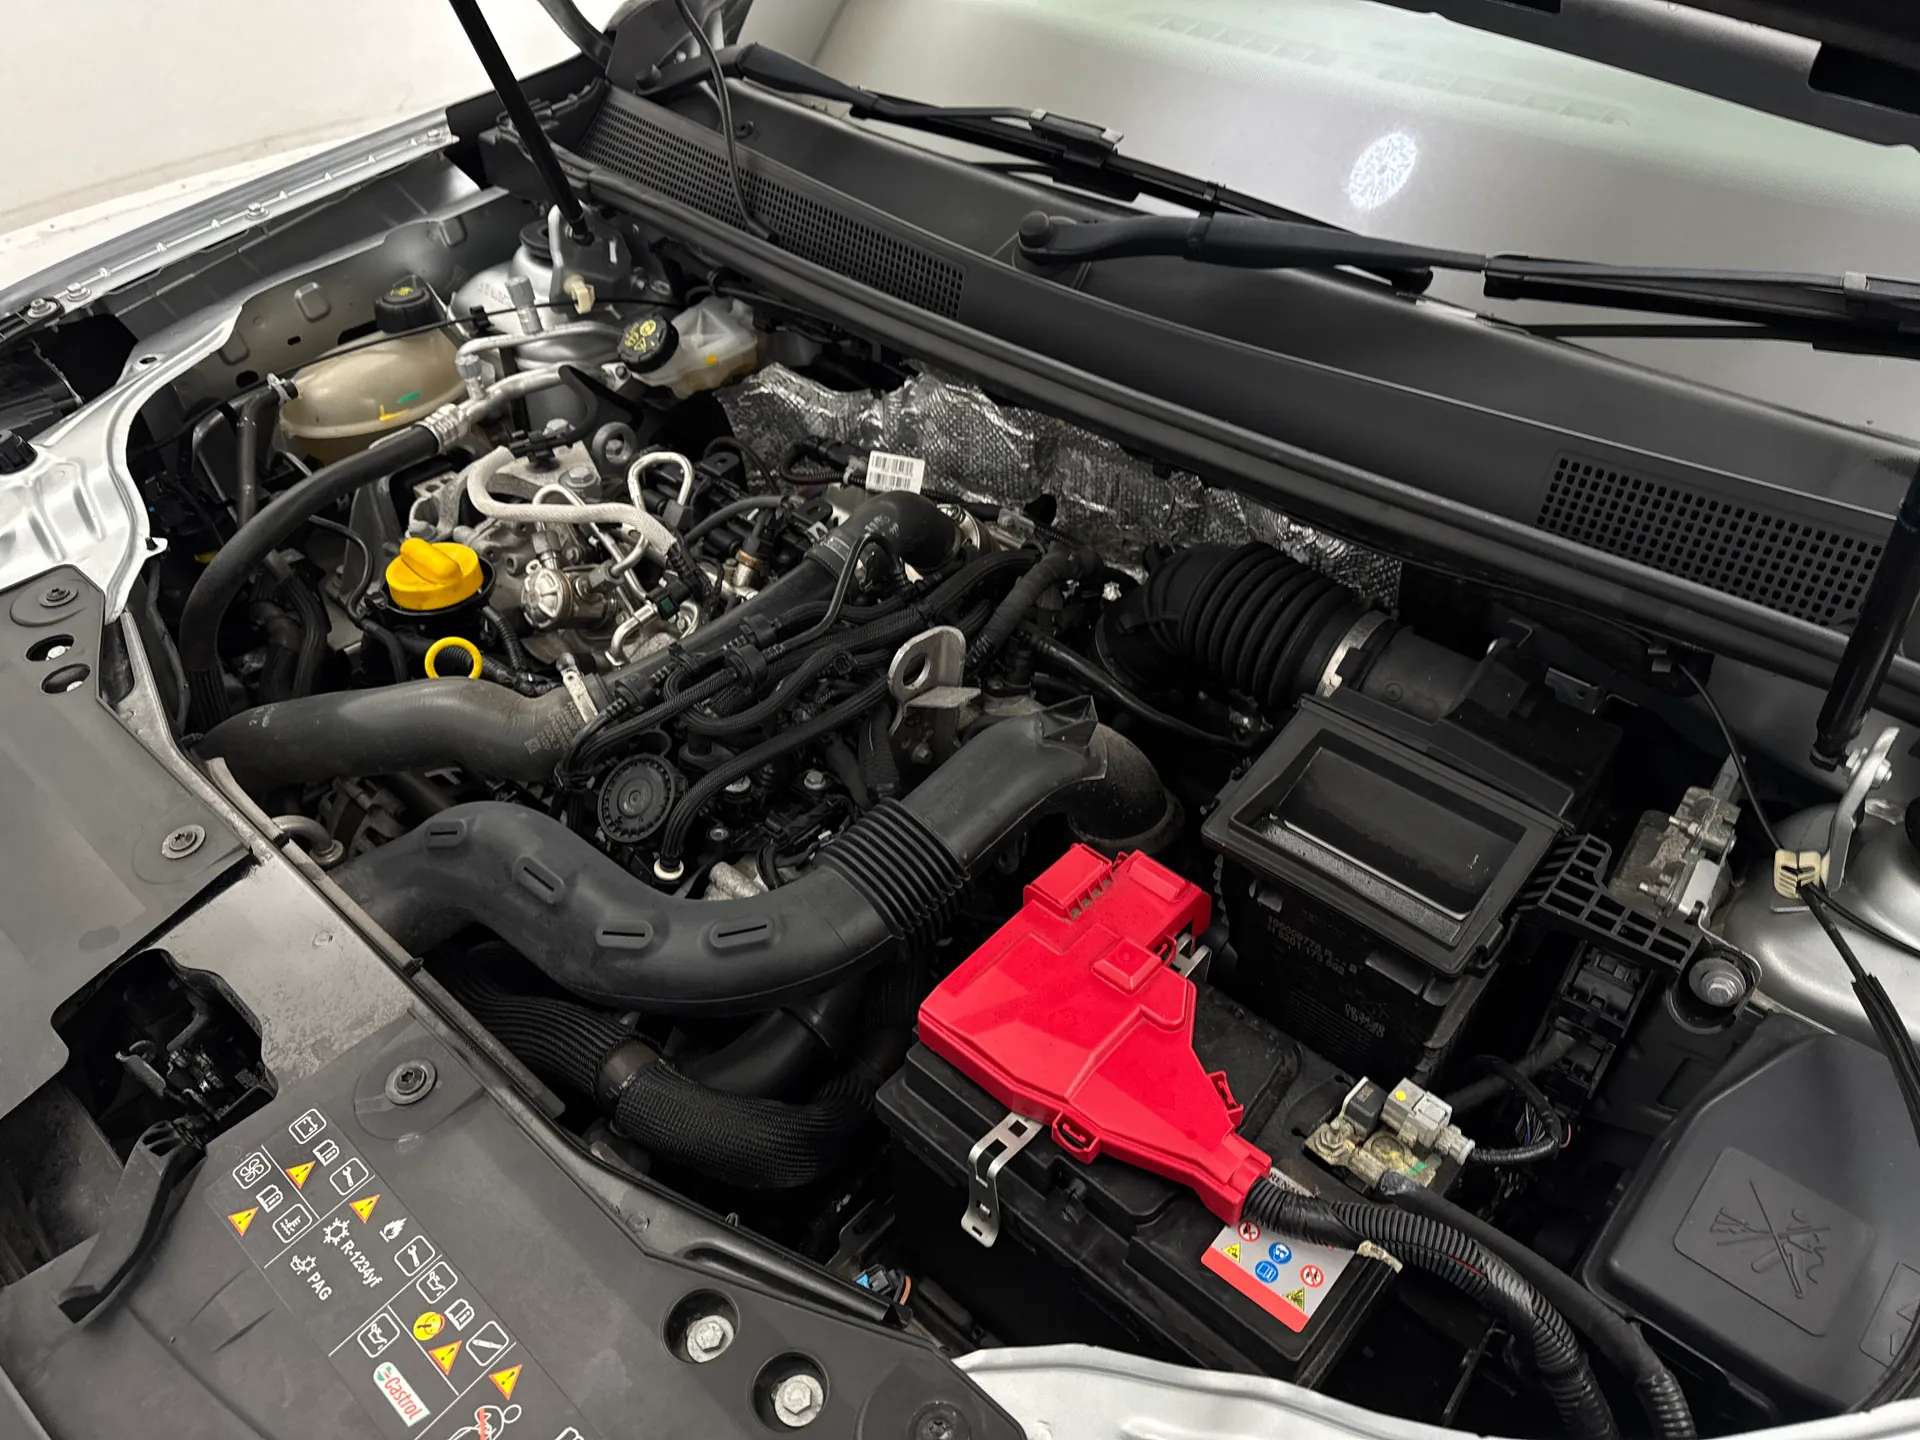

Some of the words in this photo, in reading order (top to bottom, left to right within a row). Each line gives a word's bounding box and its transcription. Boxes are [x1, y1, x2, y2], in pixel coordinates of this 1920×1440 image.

[340, 1239, 383, 1288] R-1234yf
[307, 1271, 332, 1300] PAG
[384, 1377, 423, 1420] Castrol
